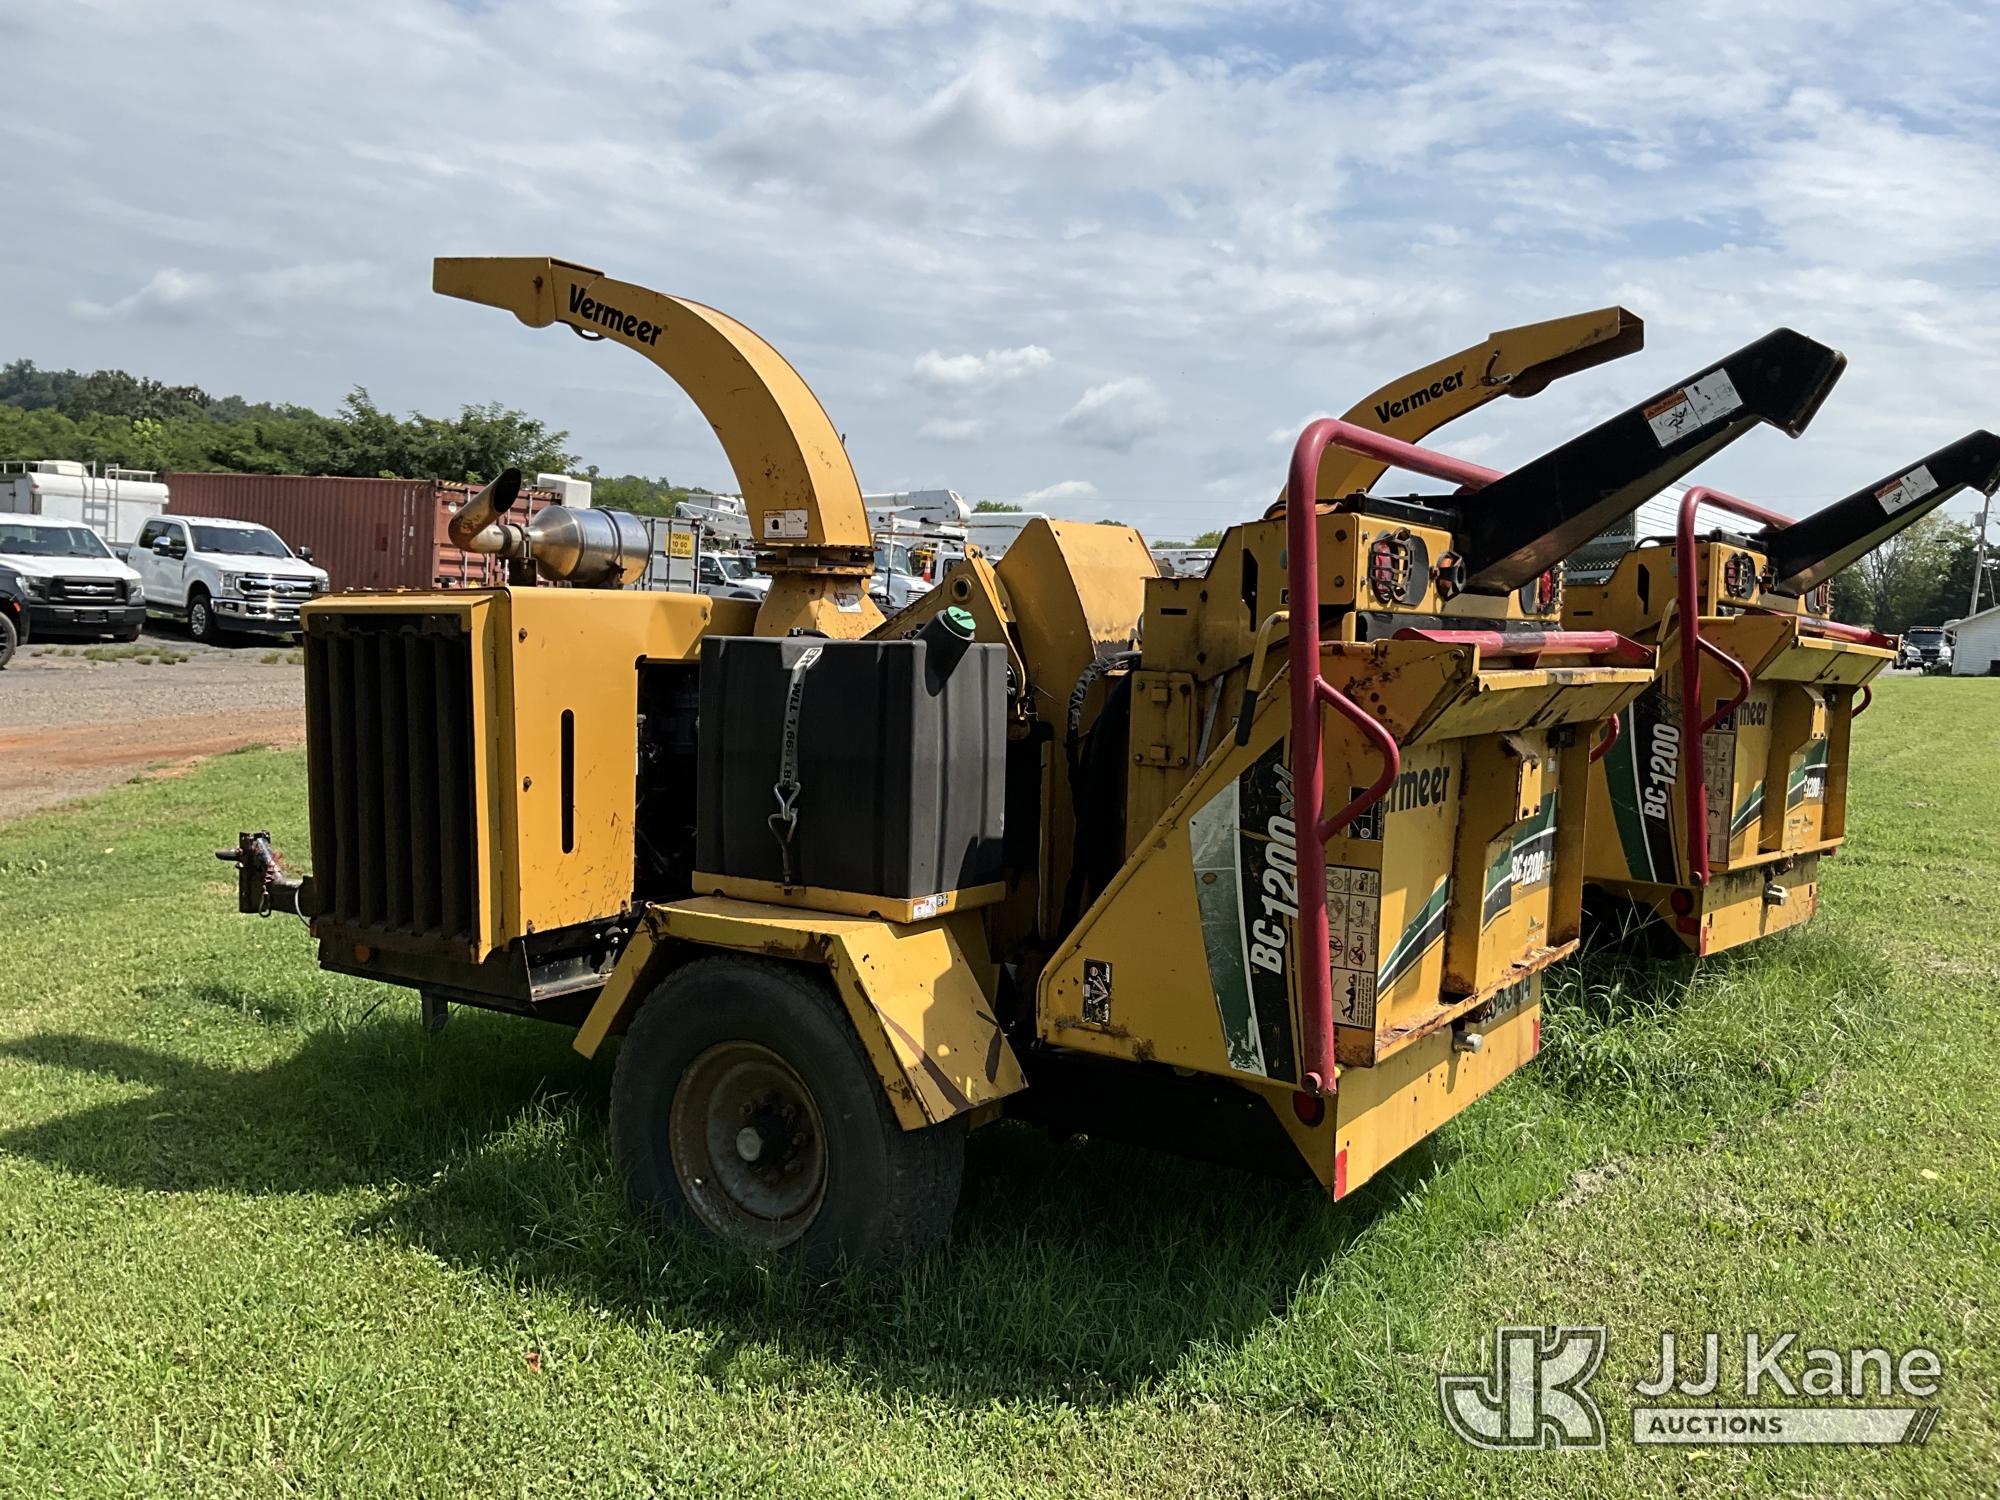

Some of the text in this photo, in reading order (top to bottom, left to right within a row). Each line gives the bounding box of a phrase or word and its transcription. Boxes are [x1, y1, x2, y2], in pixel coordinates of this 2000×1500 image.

[569, 283, 662, 346] Vermeer
[1374, 370, 1464, 424] Vermeer
[1738, 702, 1768, 726] meer
[1386, 766, 1450, 813] rmeer
